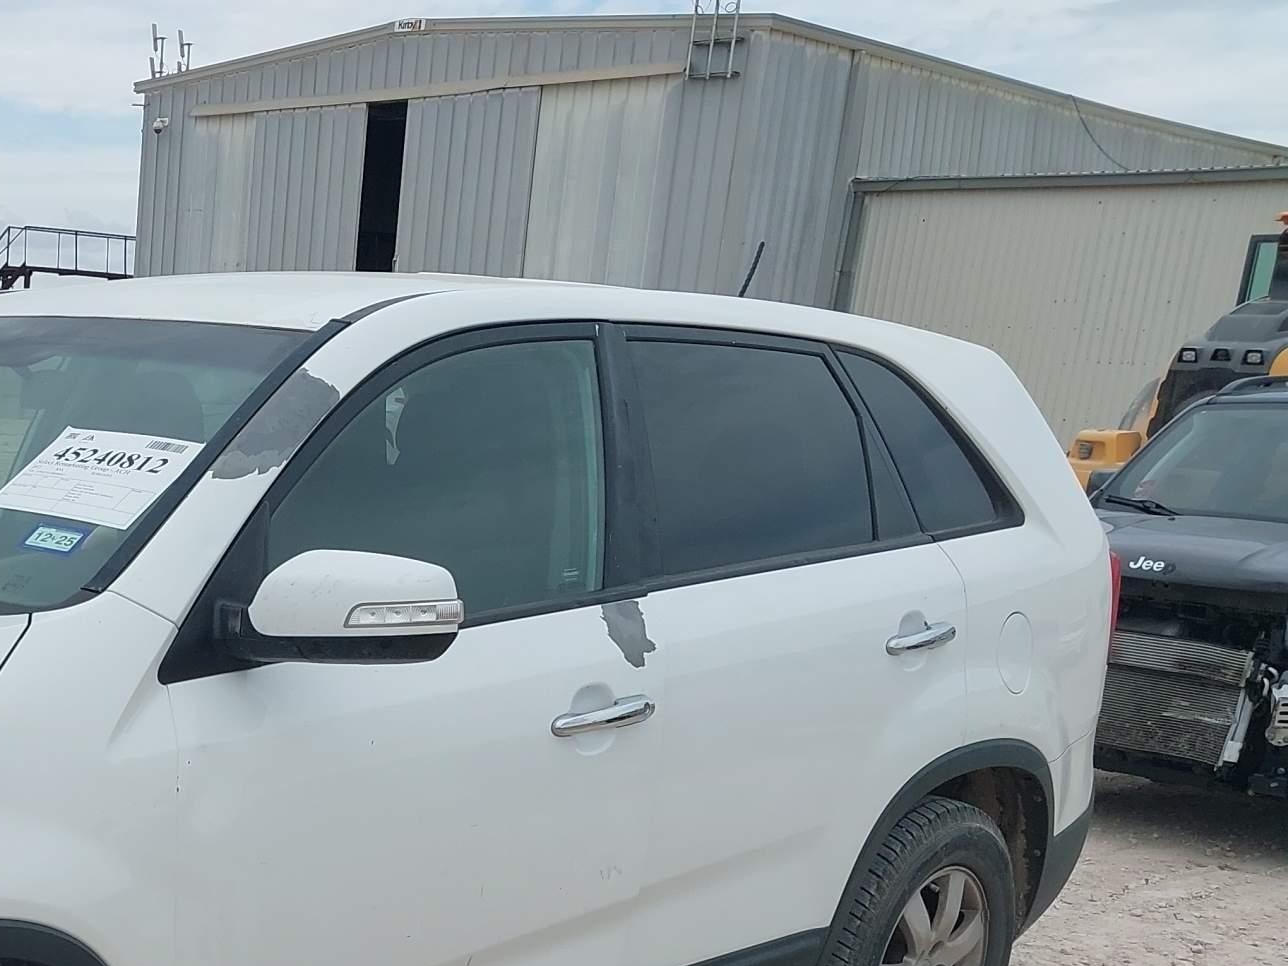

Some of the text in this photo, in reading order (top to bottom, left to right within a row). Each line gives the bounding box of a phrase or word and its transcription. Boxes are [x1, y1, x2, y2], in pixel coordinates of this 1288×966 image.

[54, 446, 169, 475] 45240812
[34, 531, 77, 547] 12 25
